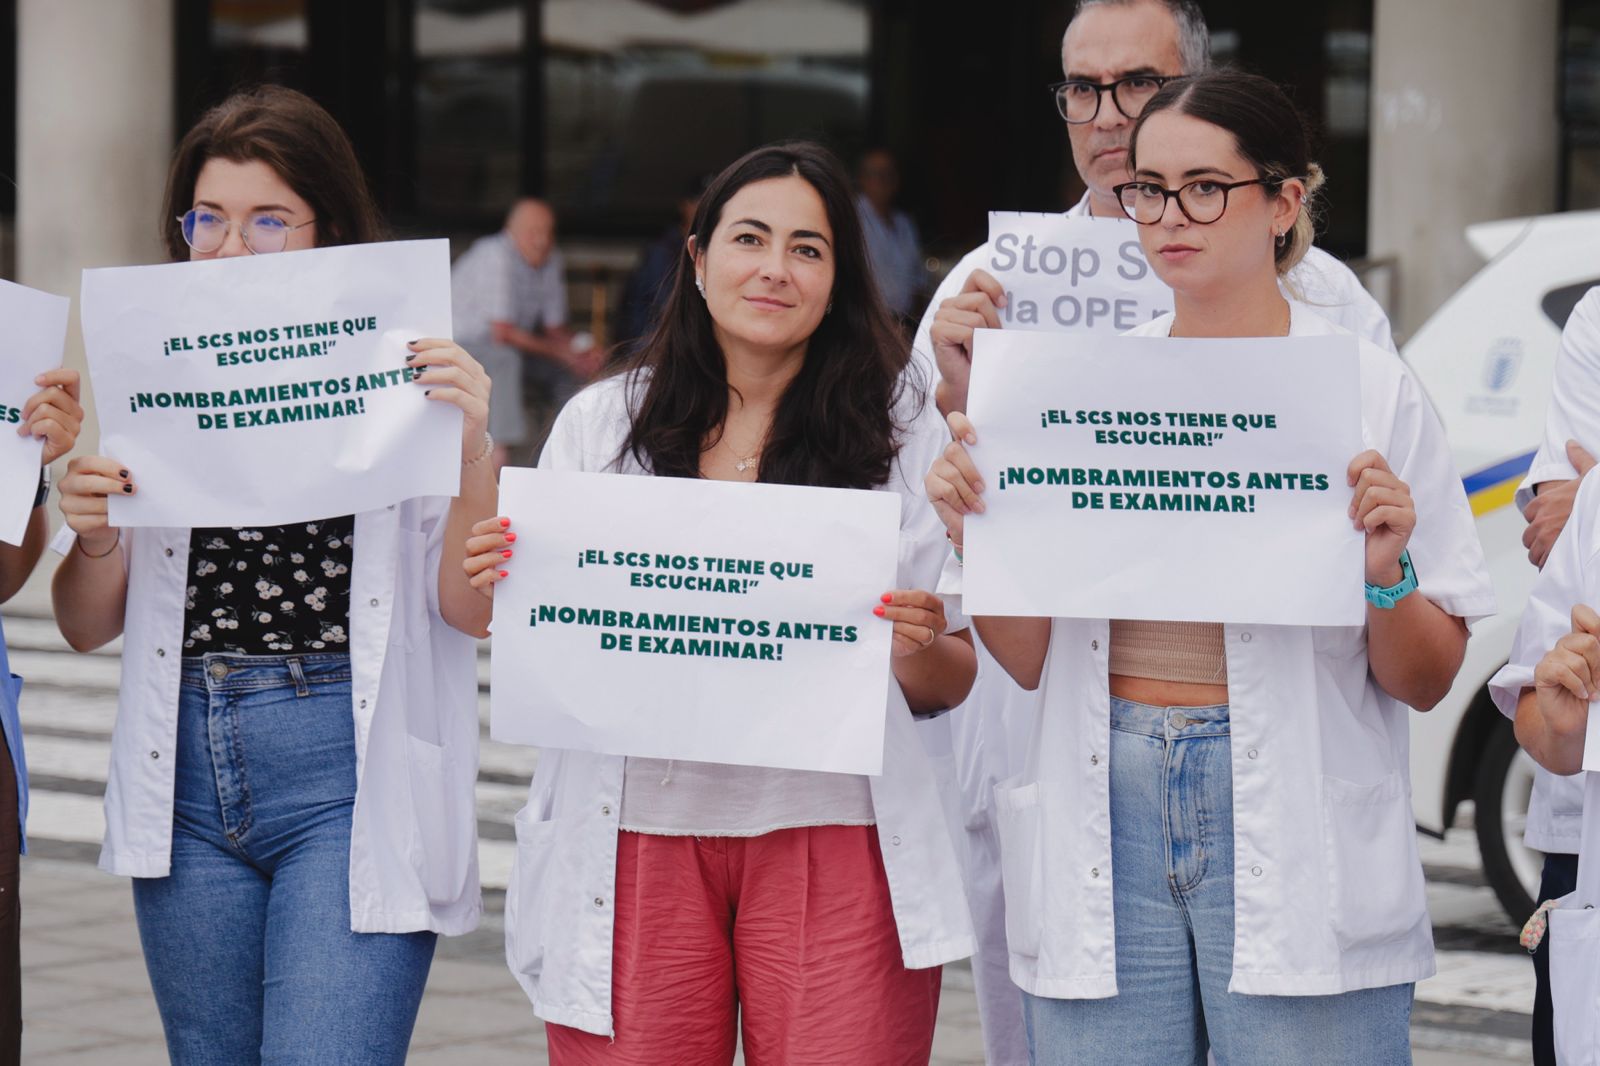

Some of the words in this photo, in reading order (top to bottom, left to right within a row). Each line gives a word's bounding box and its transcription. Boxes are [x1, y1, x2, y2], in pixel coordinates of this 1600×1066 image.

[991, 233, 1100, 287] Stop
[1052, 295, 1138, 330] OPE
[164, 336, 193, 356] ¡EL
[197, 333, 234, 349] SCS
[238, 327, 280, 345] NOS
[283, 321, 340, 340] TIENE
[342, 316, 377, 336] QUE
[130, 376, 351, 413] ¡NOMBRAMIENTOS
[197, 412, 229, 430] DE
[233, 396, 365, 429] EXAMINAR!
[1042, 409, 1072, 428] ¡EL
[1075, 410, 1113, 425] SCS
[1117, 411, 1161, 426] NOS
[1165, 412, 1228, 428] TIENE
[1231, 413, 1277, 432] QUE
[999, 467, 1241, 490] ¡NOMBRAMIENTOS
[1245, 472, 1330, 491] ANTES
[1071, 491, 1104, 510] DE
[1109, 492, 1256, 513] EXAMINAR!
[578, 550, 609, 569] ¡EL
[613, 551, 651, 568] SCS
[655, 554, 699, 571] NOS
[703, 557, 765, 576] TIENE
[769, 561, 814, 581] QUE
[529, 604, 771, 639] ¡NOMBRAMIENTOS
[775, 622, 858, 643] ANTES
[600, 632, 633, 652] DE
[638, 635, 784, 661] EXAMINAR!
